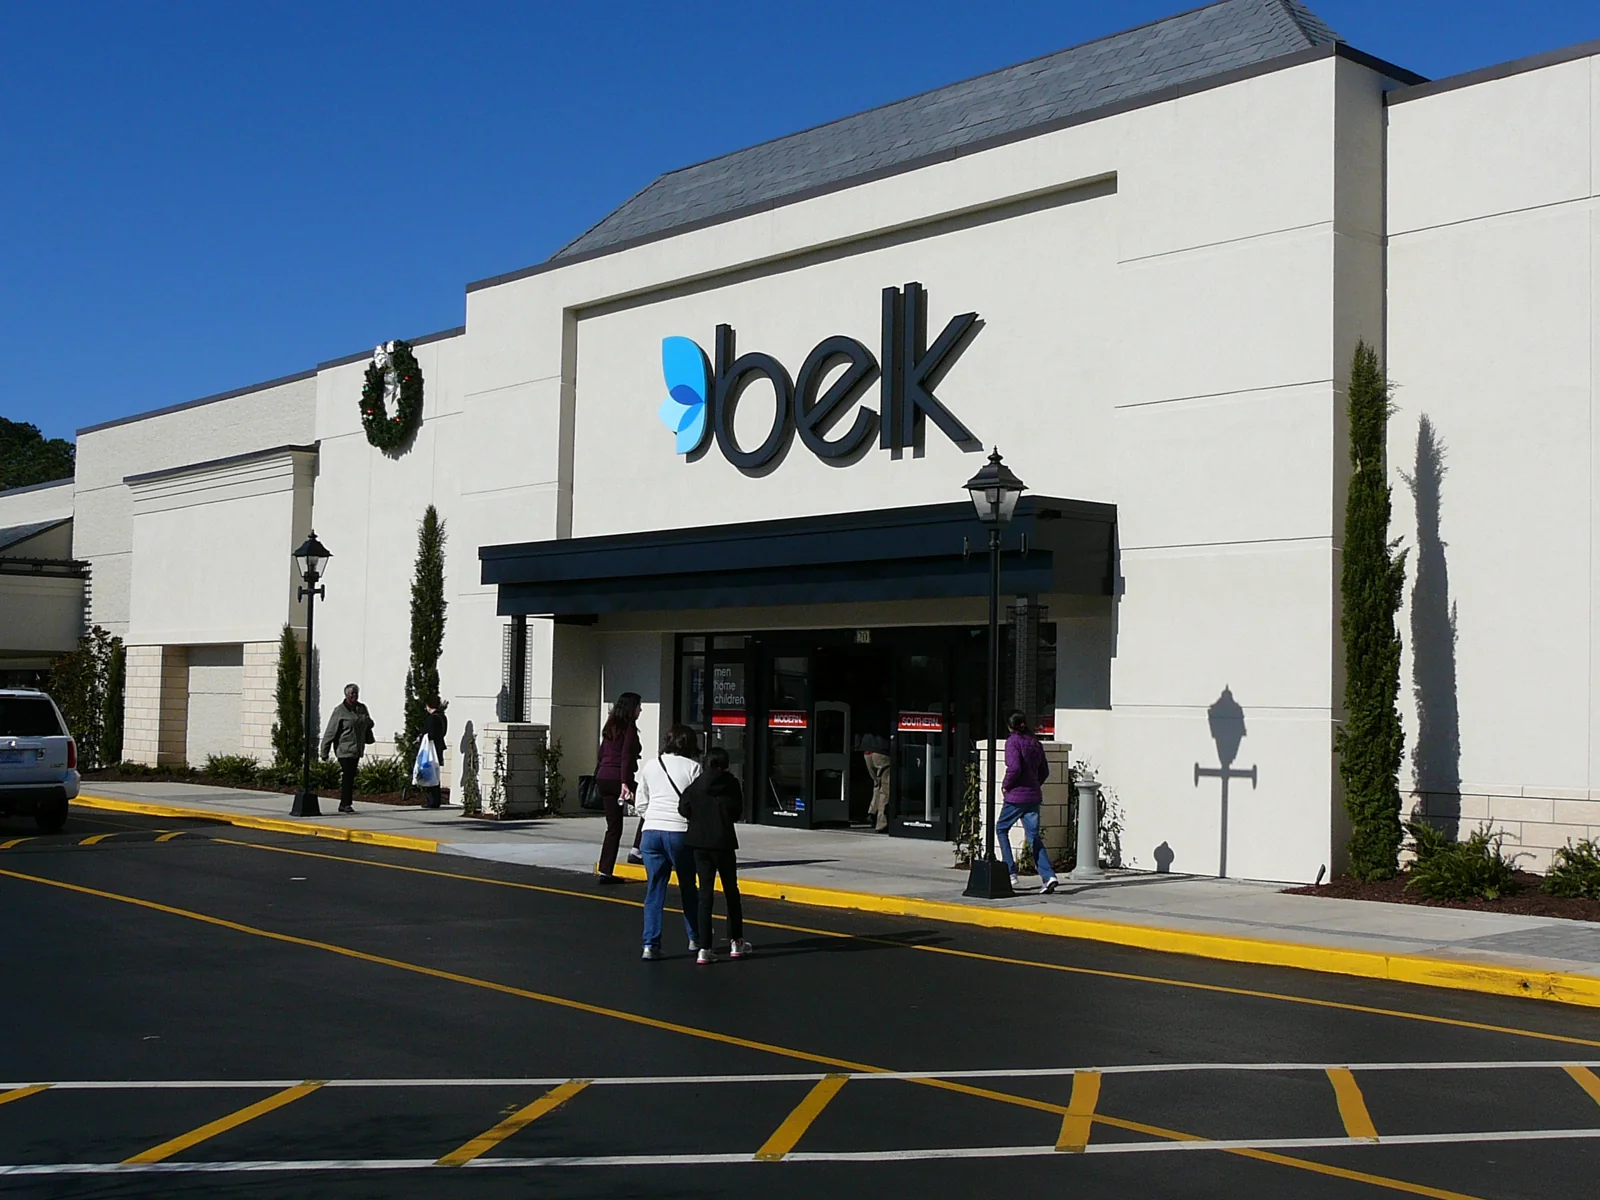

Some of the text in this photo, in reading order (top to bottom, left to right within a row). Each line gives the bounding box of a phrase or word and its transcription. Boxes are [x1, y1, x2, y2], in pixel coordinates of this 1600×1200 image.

[714, 281, 980, 469] belk
[714, 668, 731, 677] men
[713, 680, 736, 691] home
[713, 693, 745, 705] children
